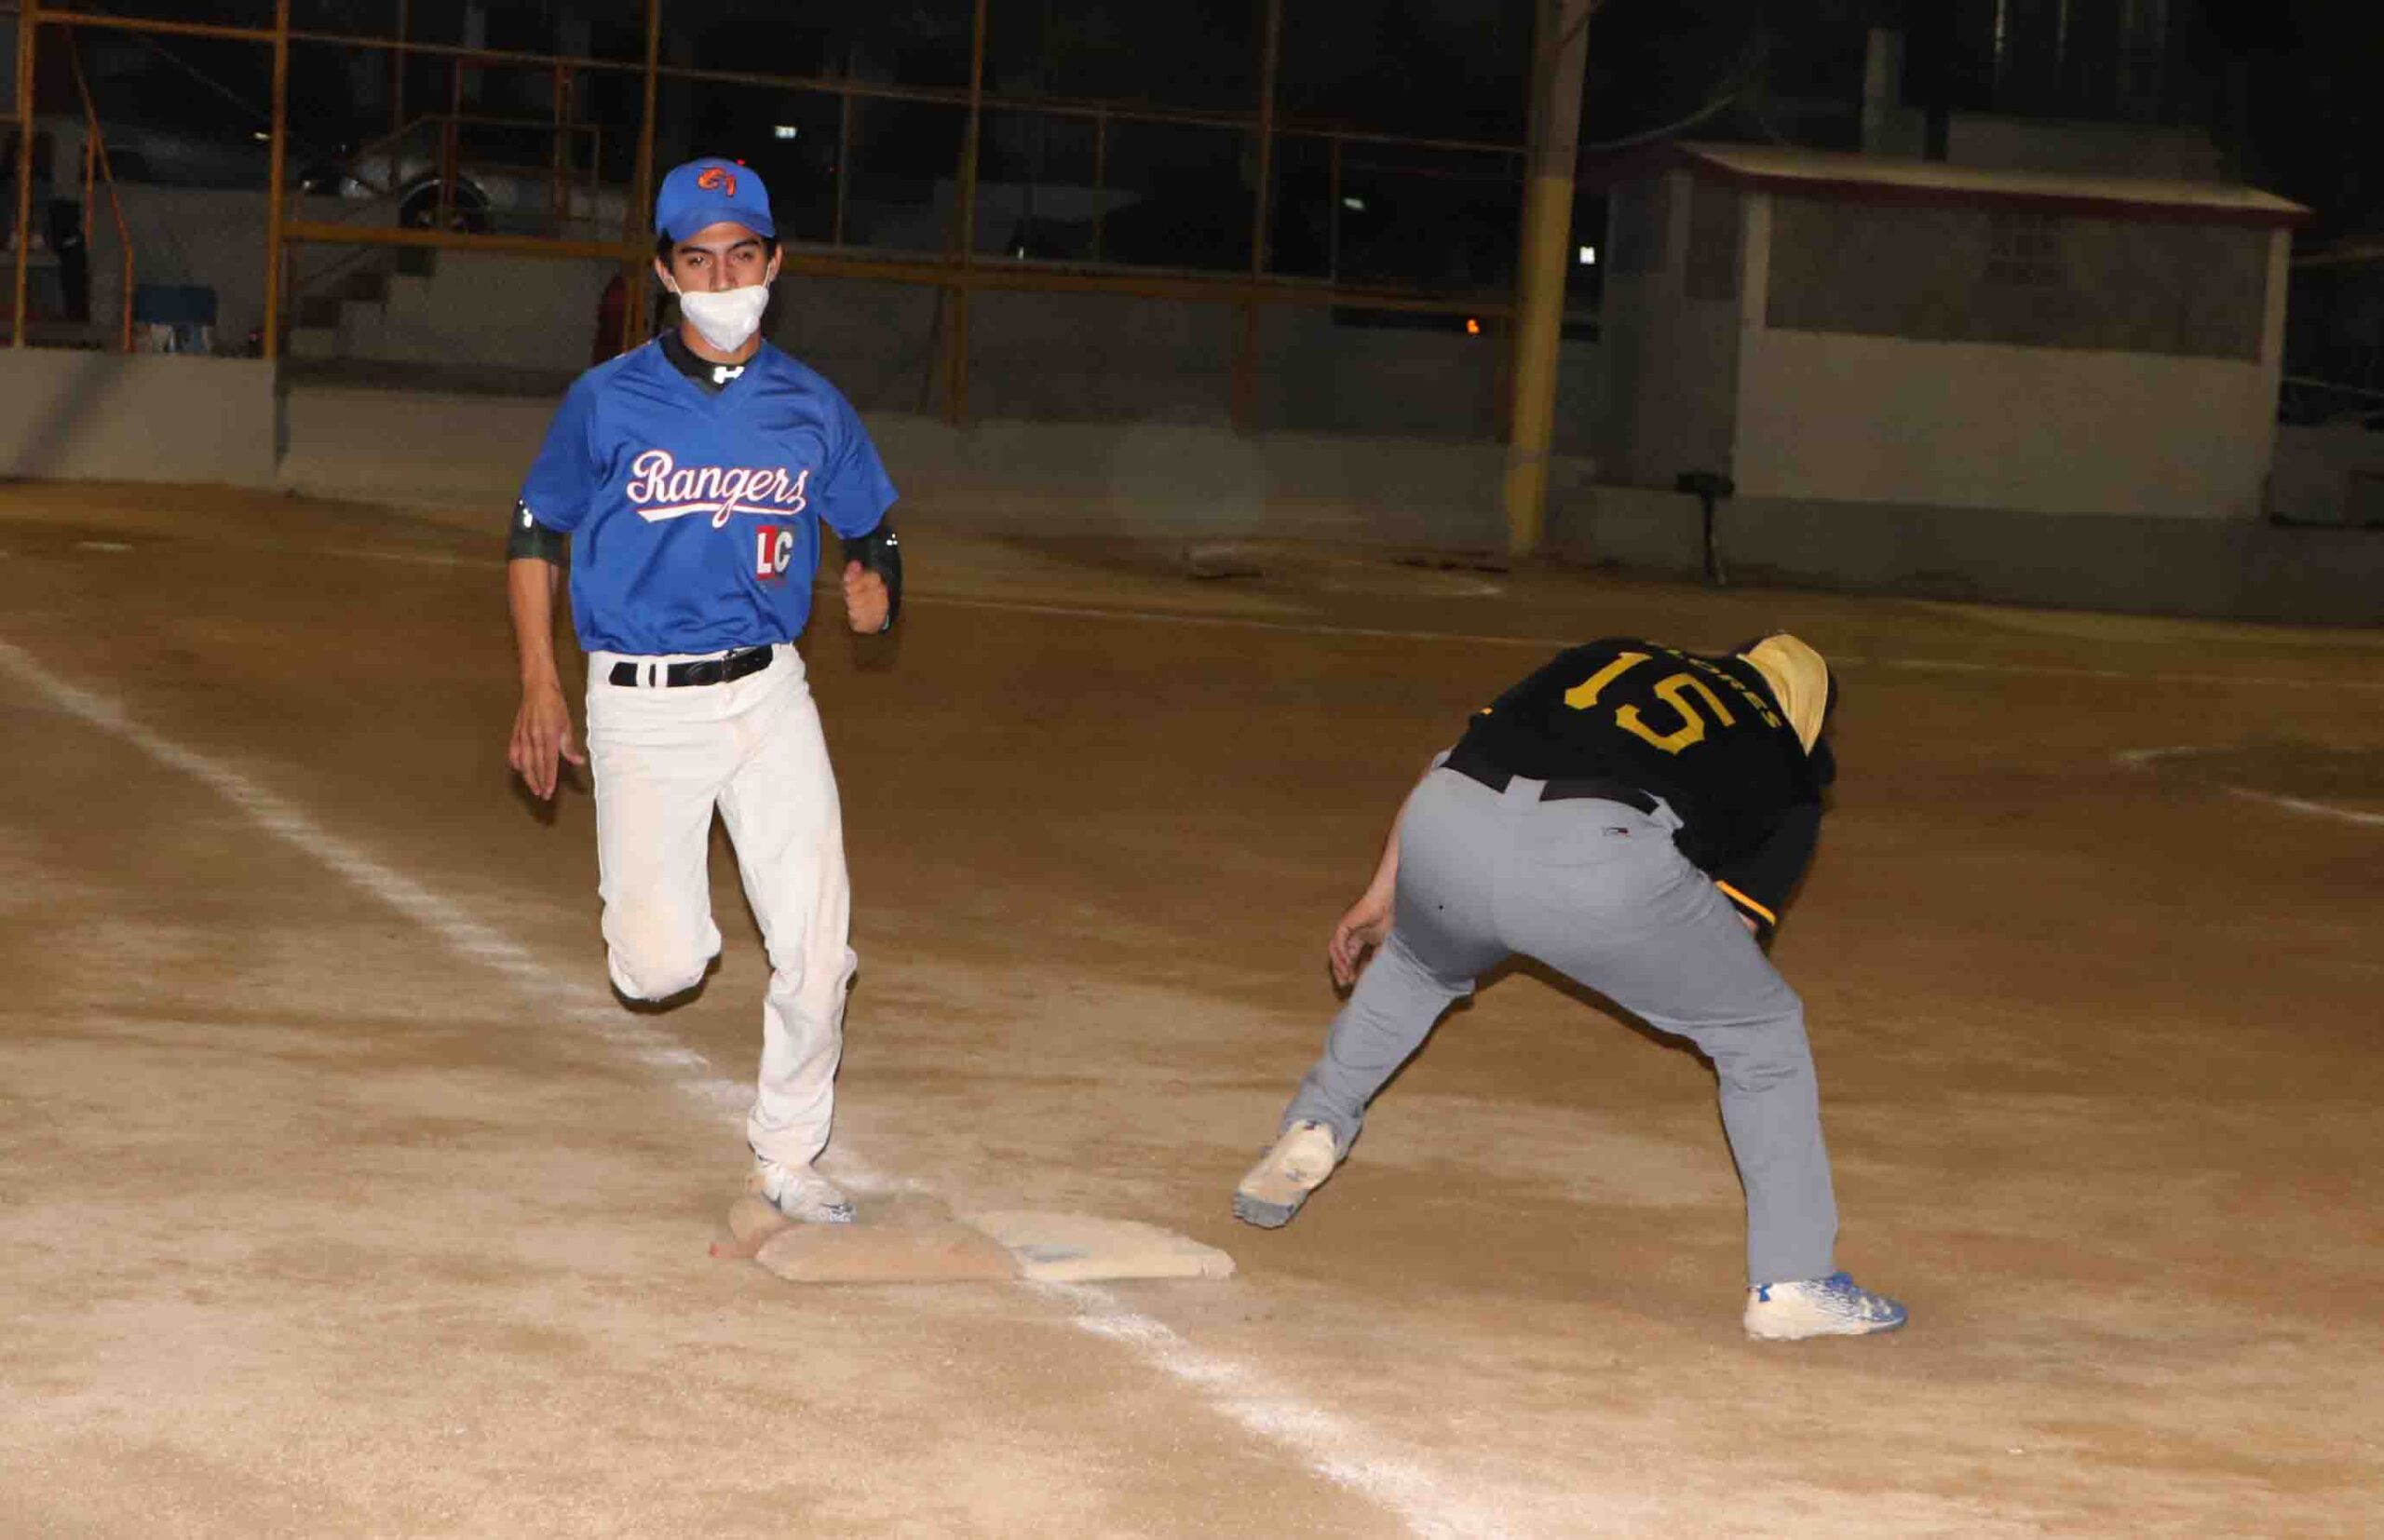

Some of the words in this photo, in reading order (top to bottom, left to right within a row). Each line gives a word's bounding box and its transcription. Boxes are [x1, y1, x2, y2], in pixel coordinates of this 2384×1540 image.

[626, 449, 809, 529] Rangers
[756, 530, 793, 574] LC
[1564, 651, 1737, 756] 15
